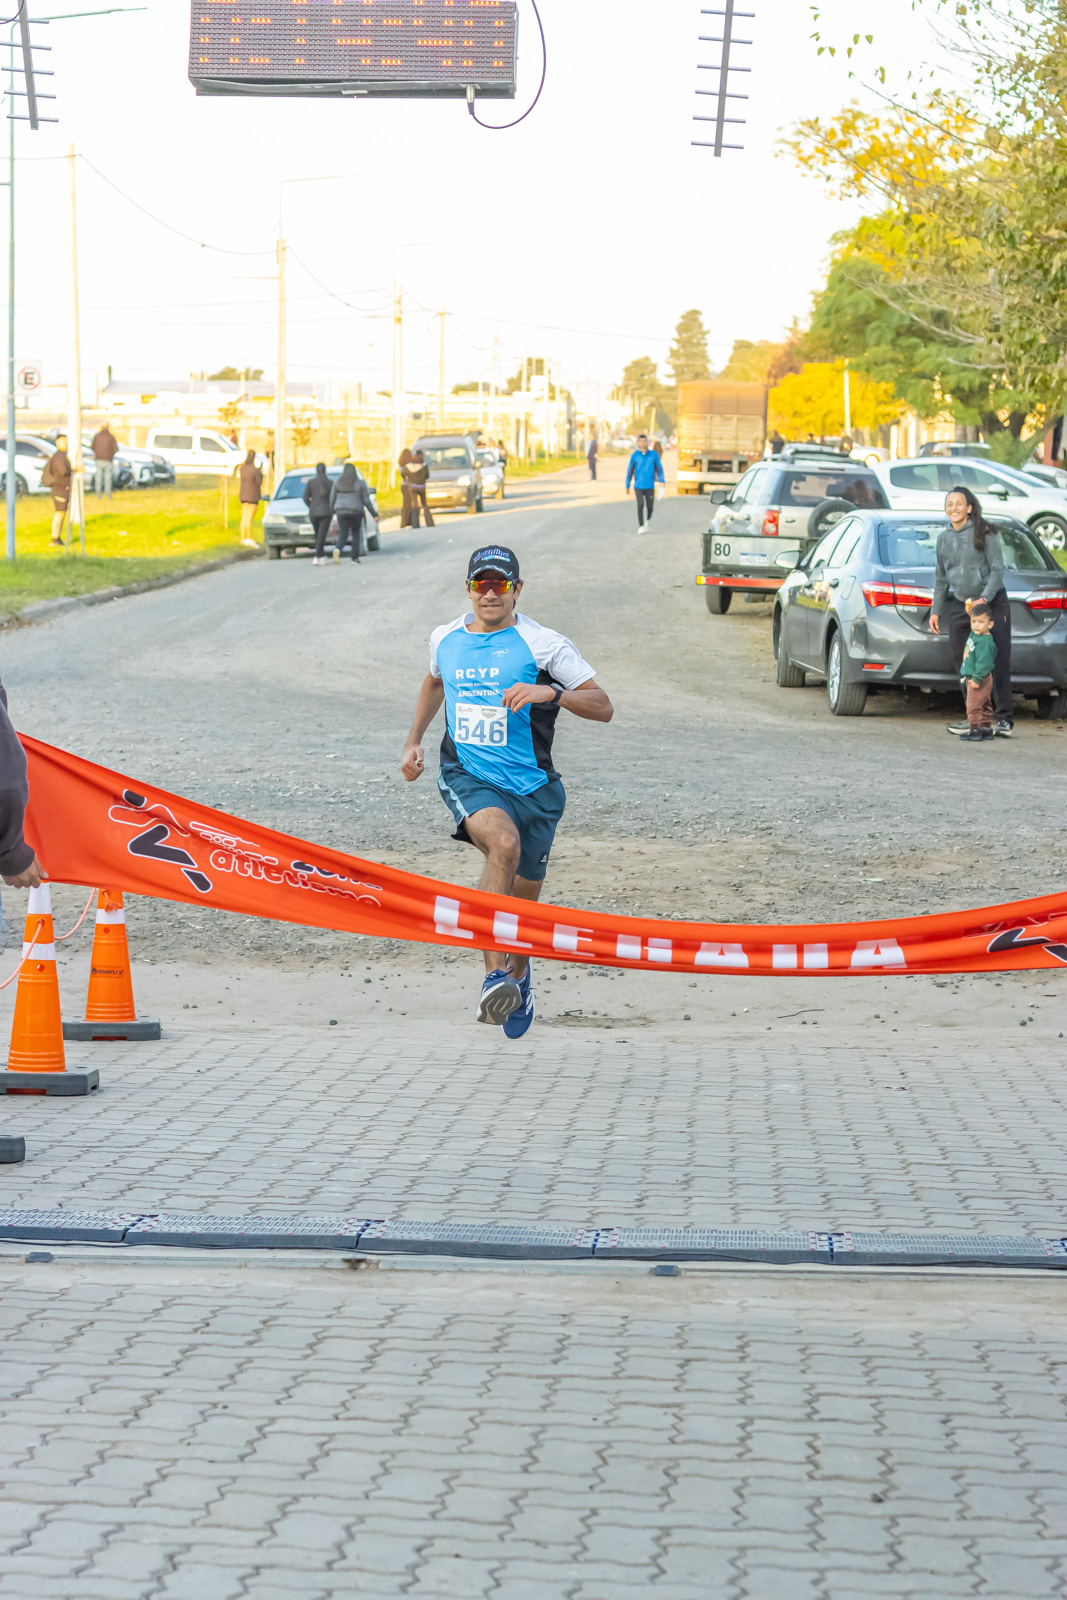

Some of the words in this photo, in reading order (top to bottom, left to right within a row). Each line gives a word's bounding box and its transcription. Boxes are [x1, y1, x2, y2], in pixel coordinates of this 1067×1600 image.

[24, 372, 35, 385] E
[714, 543, 731, 557] 80
[455, 668, 500, 680] RCYP
[458, 689, 500, 698] ARGENTINA
[457, 717, 505, 744] 546
